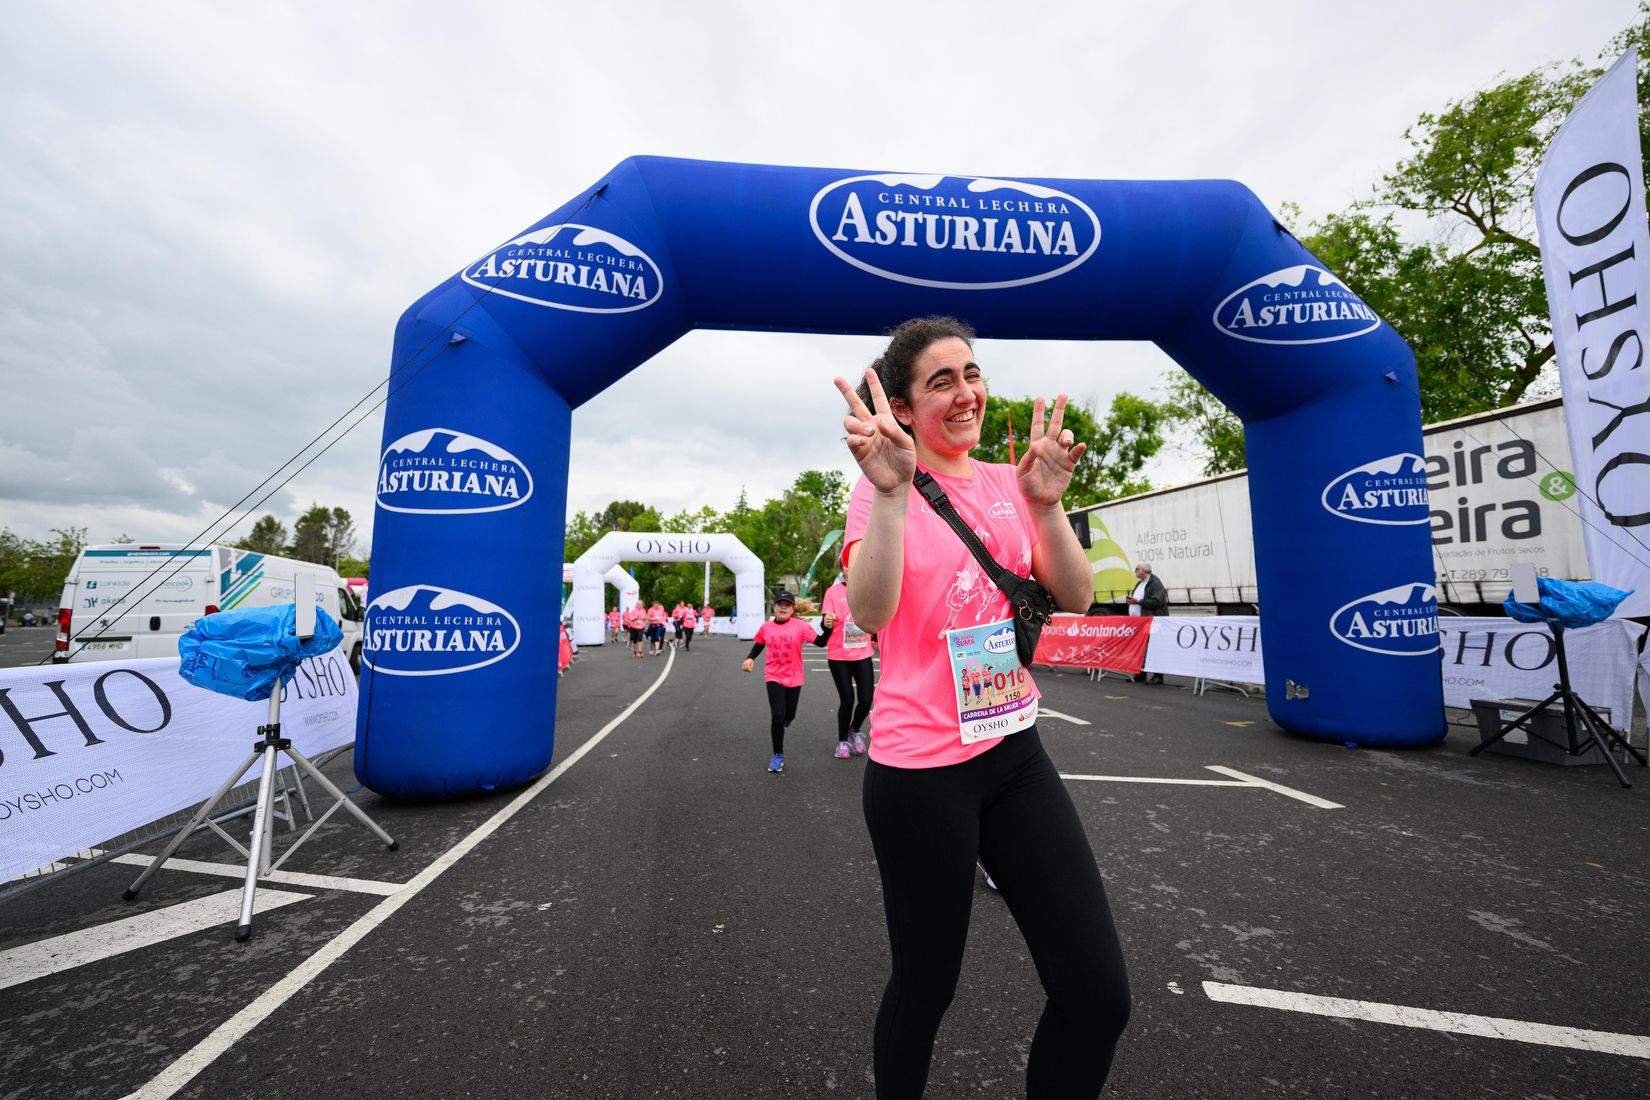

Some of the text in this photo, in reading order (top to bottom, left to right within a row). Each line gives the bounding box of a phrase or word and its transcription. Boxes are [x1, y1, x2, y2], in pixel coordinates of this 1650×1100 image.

[878, 192, 1070, 215] CENTRAL LECHERA
[832, 191, 1079, 256] ASTURIANA
[507, 248, 645, 272] CENTRAL LECHERA
[471, 254, 648, 301] ASTURIANA
[1263, 289, 1322, 302] CENTRAL
[1228, 297, 1376, 329] ASTURIANA
[1556, 161, 1650, 528] OYSHO
[392, 458, 516, 475] CENTRAL LECHERA
[378, 463, 520, 500] ASTURIANA
[1365, 477, 1414, 487] CENTRAL
[1136, 528, 1187, 546] Alfarroba
[636, 538, 711, 555] OYSHO
[1136, 541, 1214, 562] 100% Natural
[375, 616, 502, 626] CENTRAL LECHERA
[1374, 608, 1423, 617] CENTRAL
[363, 617, 506, 653] ASTURIANA
[1079, 624, 1137, 637] Santander
[1005, 690, 1021, 702] 1150
[963, 710, 989, 720] CARRERA
[988, 707, 996, 715] DE
[973, 718, 1009, 733] OYSHO
